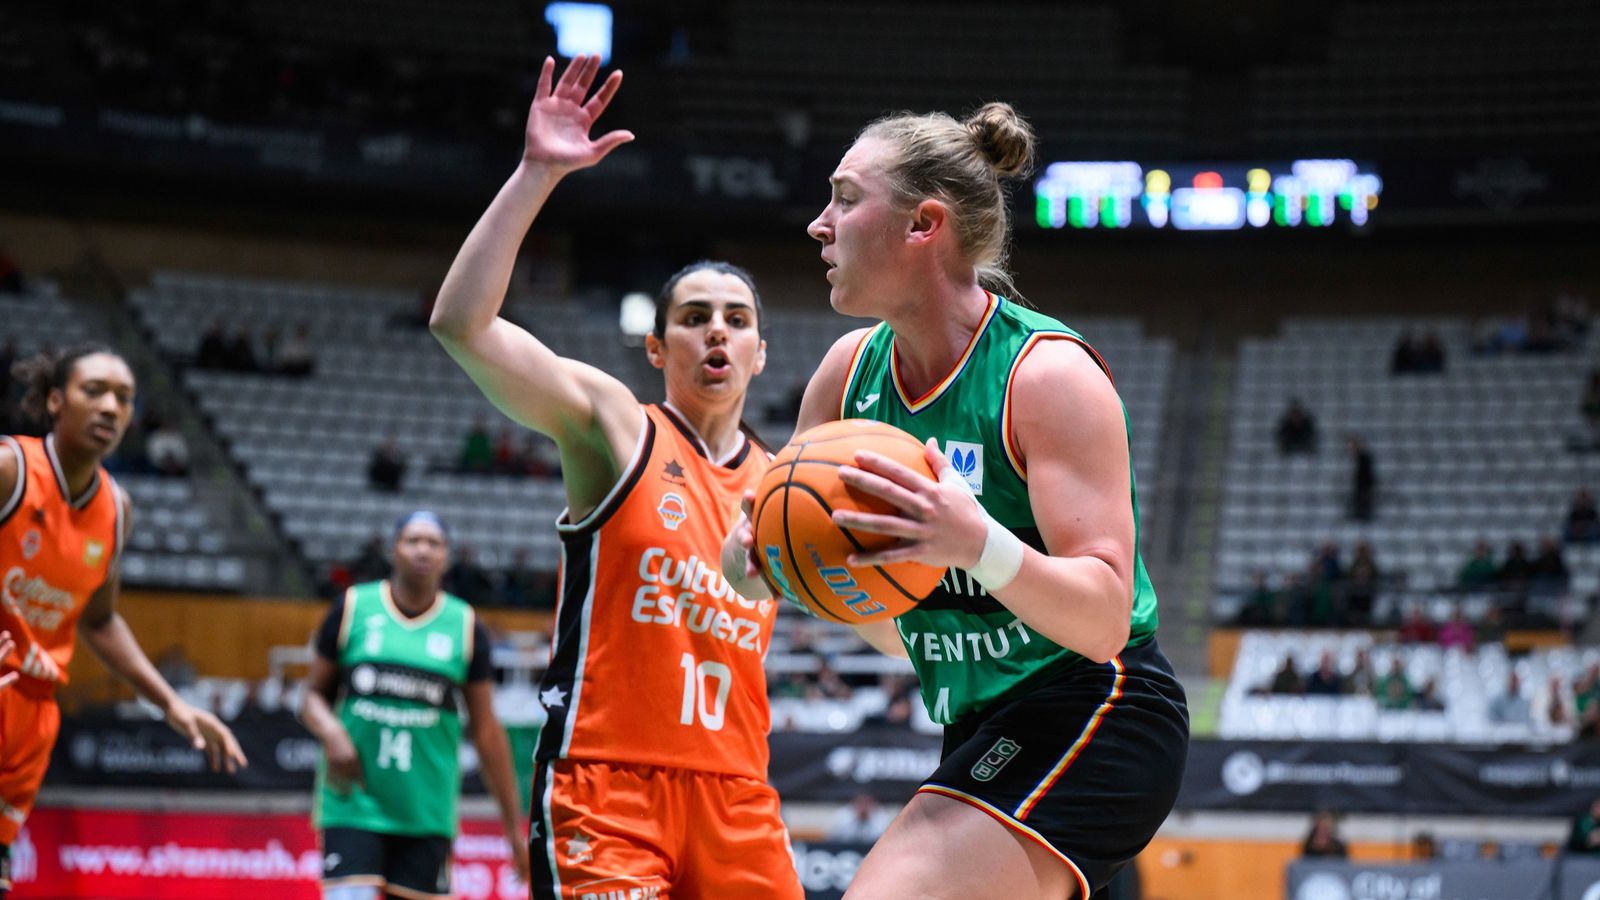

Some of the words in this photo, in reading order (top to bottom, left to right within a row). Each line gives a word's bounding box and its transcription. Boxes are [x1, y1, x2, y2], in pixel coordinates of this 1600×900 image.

[818, 566, 887, 617] EVO
[680, 652, 732, 732] 10
[378, 727, 412, 772] 14
